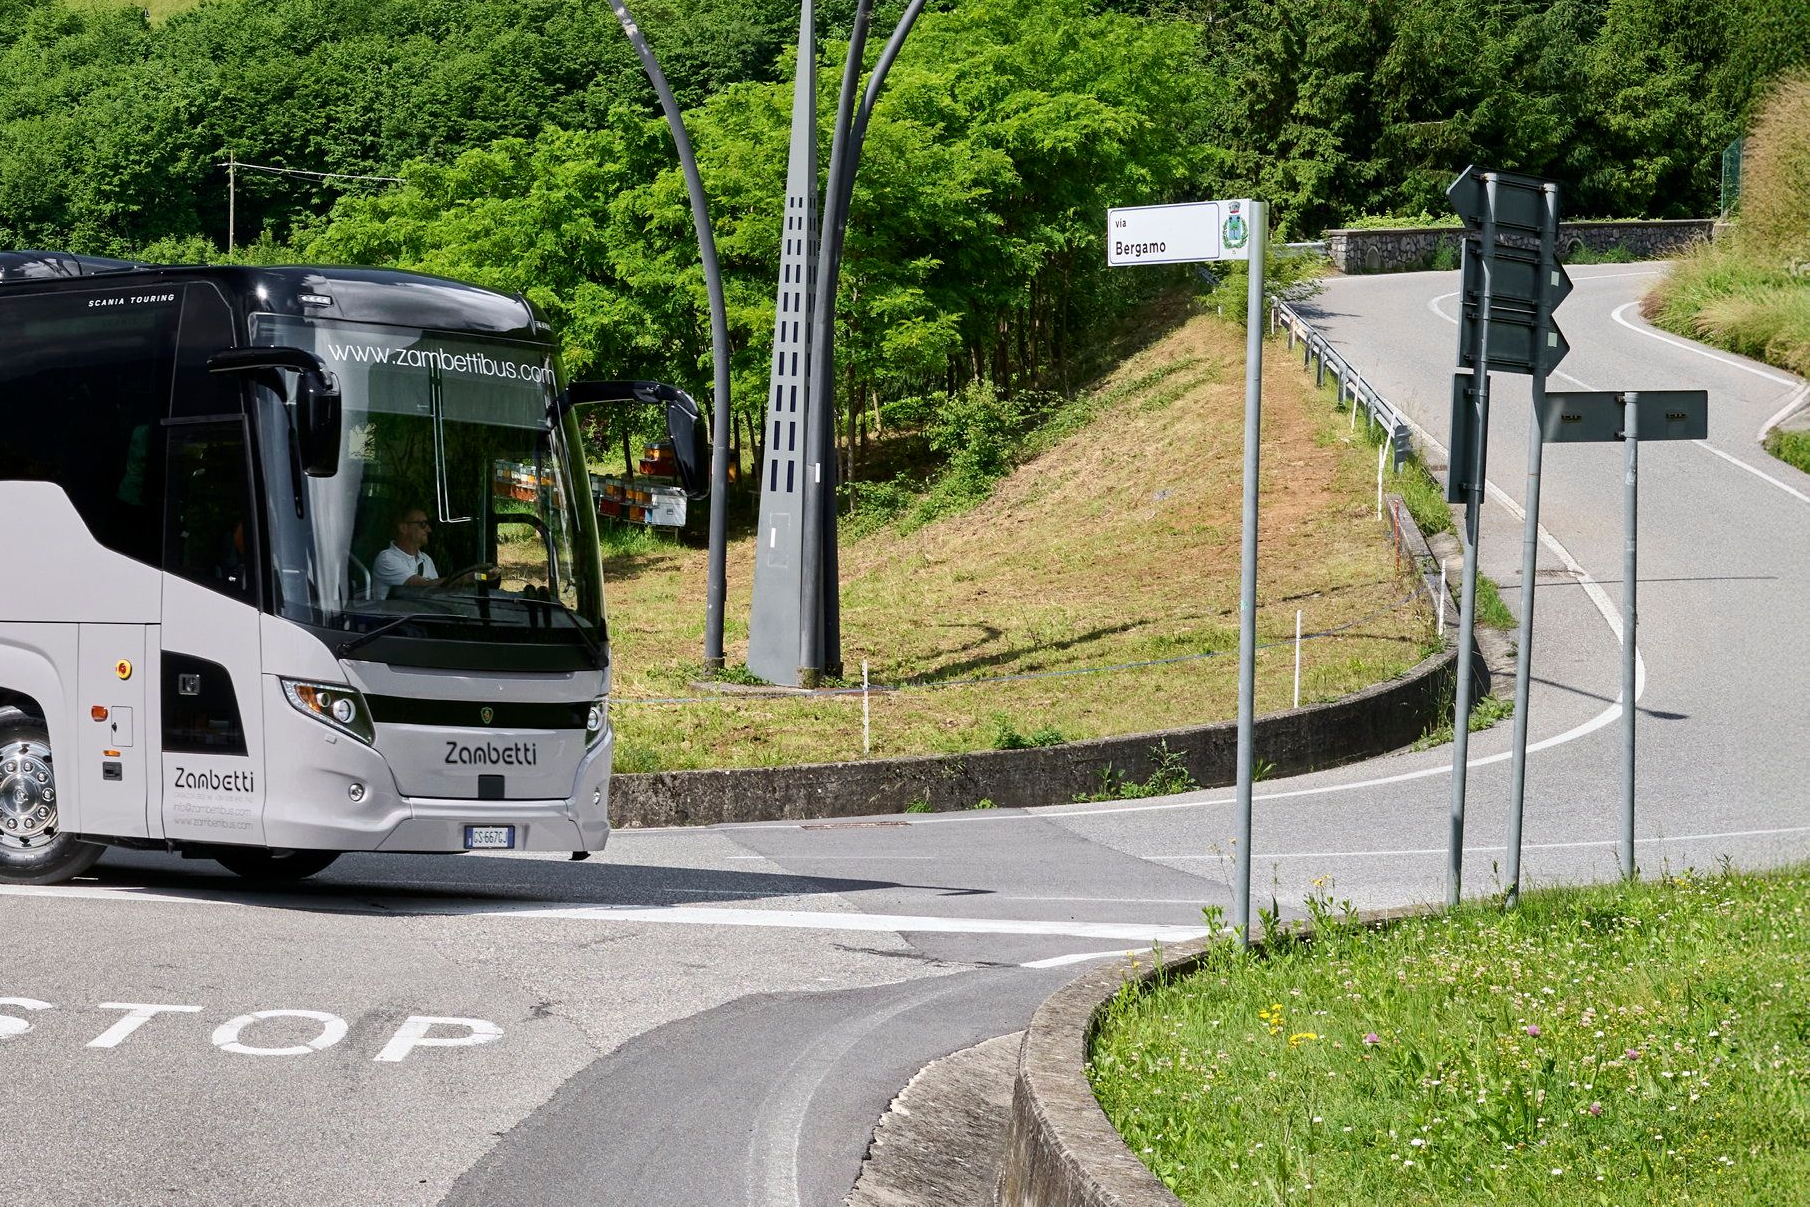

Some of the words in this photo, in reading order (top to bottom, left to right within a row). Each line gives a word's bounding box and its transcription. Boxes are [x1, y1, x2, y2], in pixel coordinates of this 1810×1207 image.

[1115, 218, 1127, 228] via
[1116, 241, 1166, 257] Bergamo
[88, 298, 125, 307] SCANIA
[130, 294, 175, 304] TOURING
[328, 344, 556, 385] www.zambettibus.com
[445, 742, 536, 765] Zambetti
[175, 767, 254, 792] Zambetti
